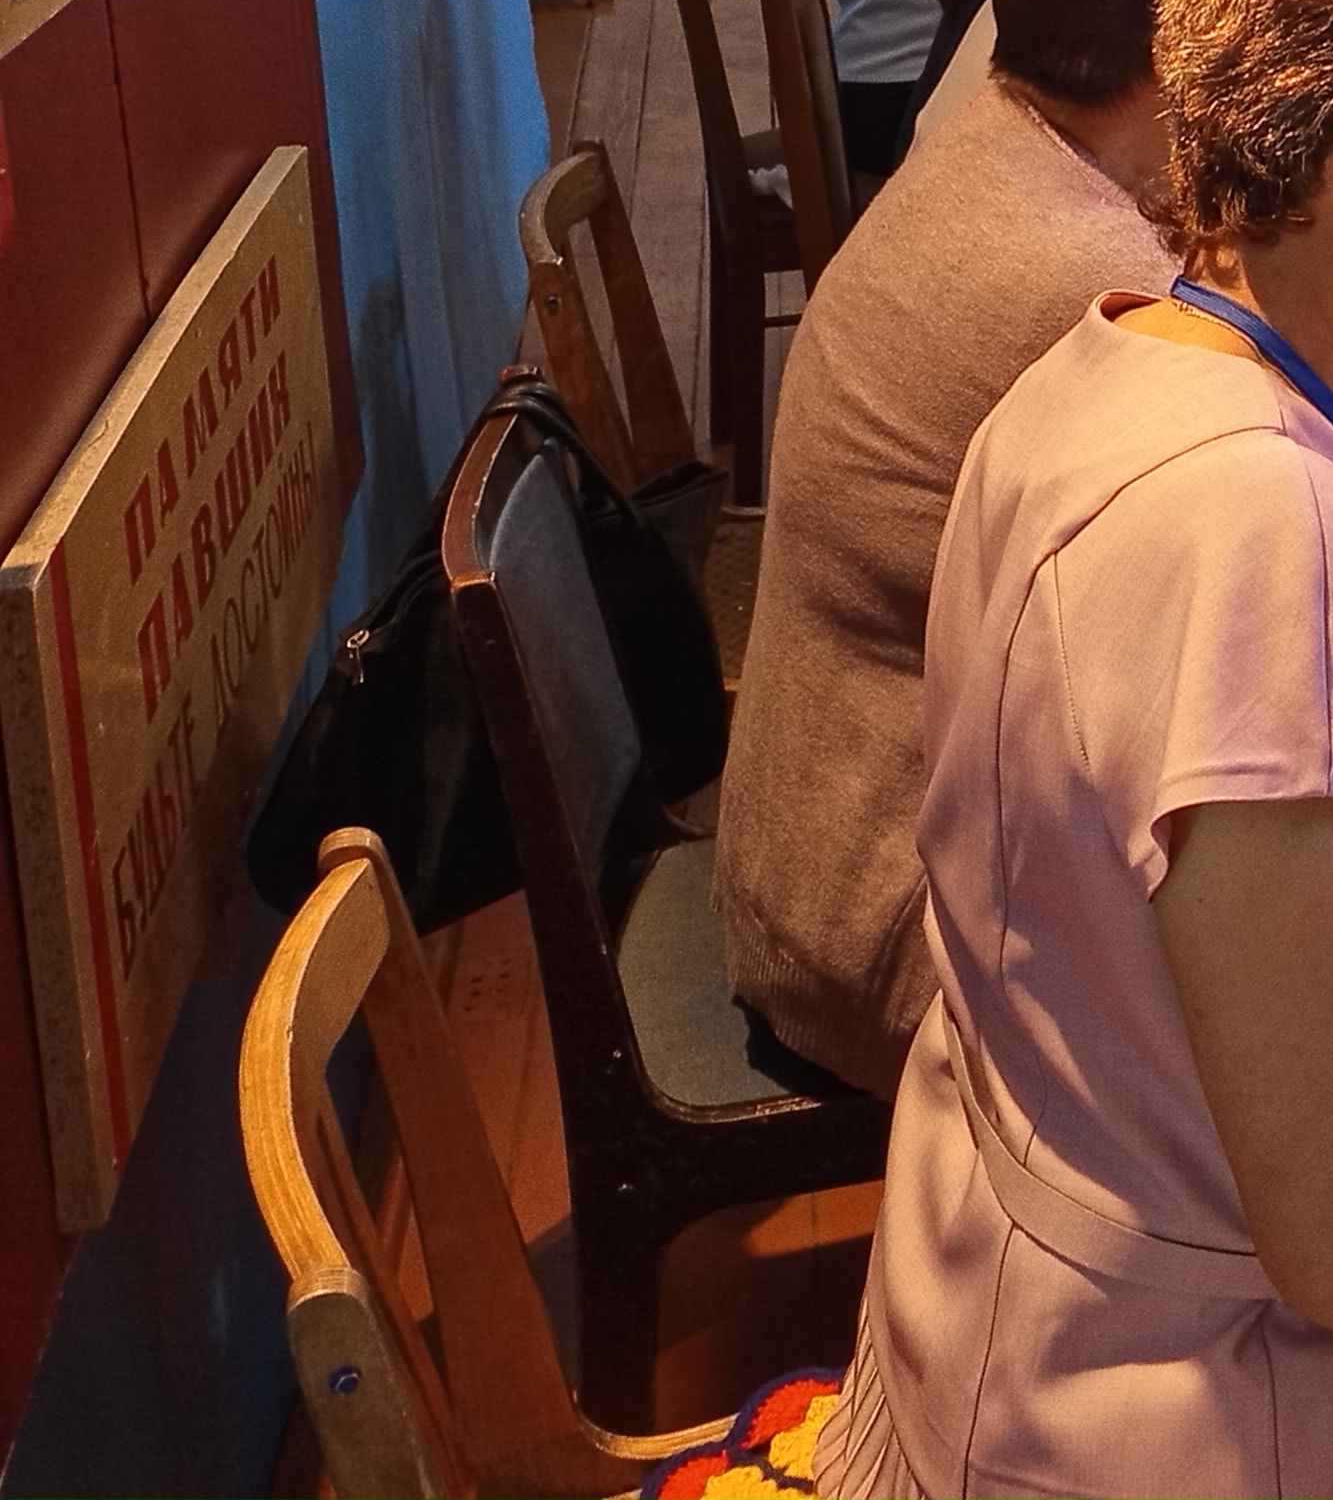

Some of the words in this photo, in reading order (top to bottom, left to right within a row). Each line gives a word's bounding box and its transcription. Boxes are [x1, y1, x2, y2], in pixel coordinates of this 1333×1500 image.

[123, 253, 281, 587] ПАМЯТИ
[137, 349, 291, 725] ПАВШИХ
[112, 689, 199, 983] БУДЬТЕ
[211, 420, 319, 747] ДОСТОЙНЫ
